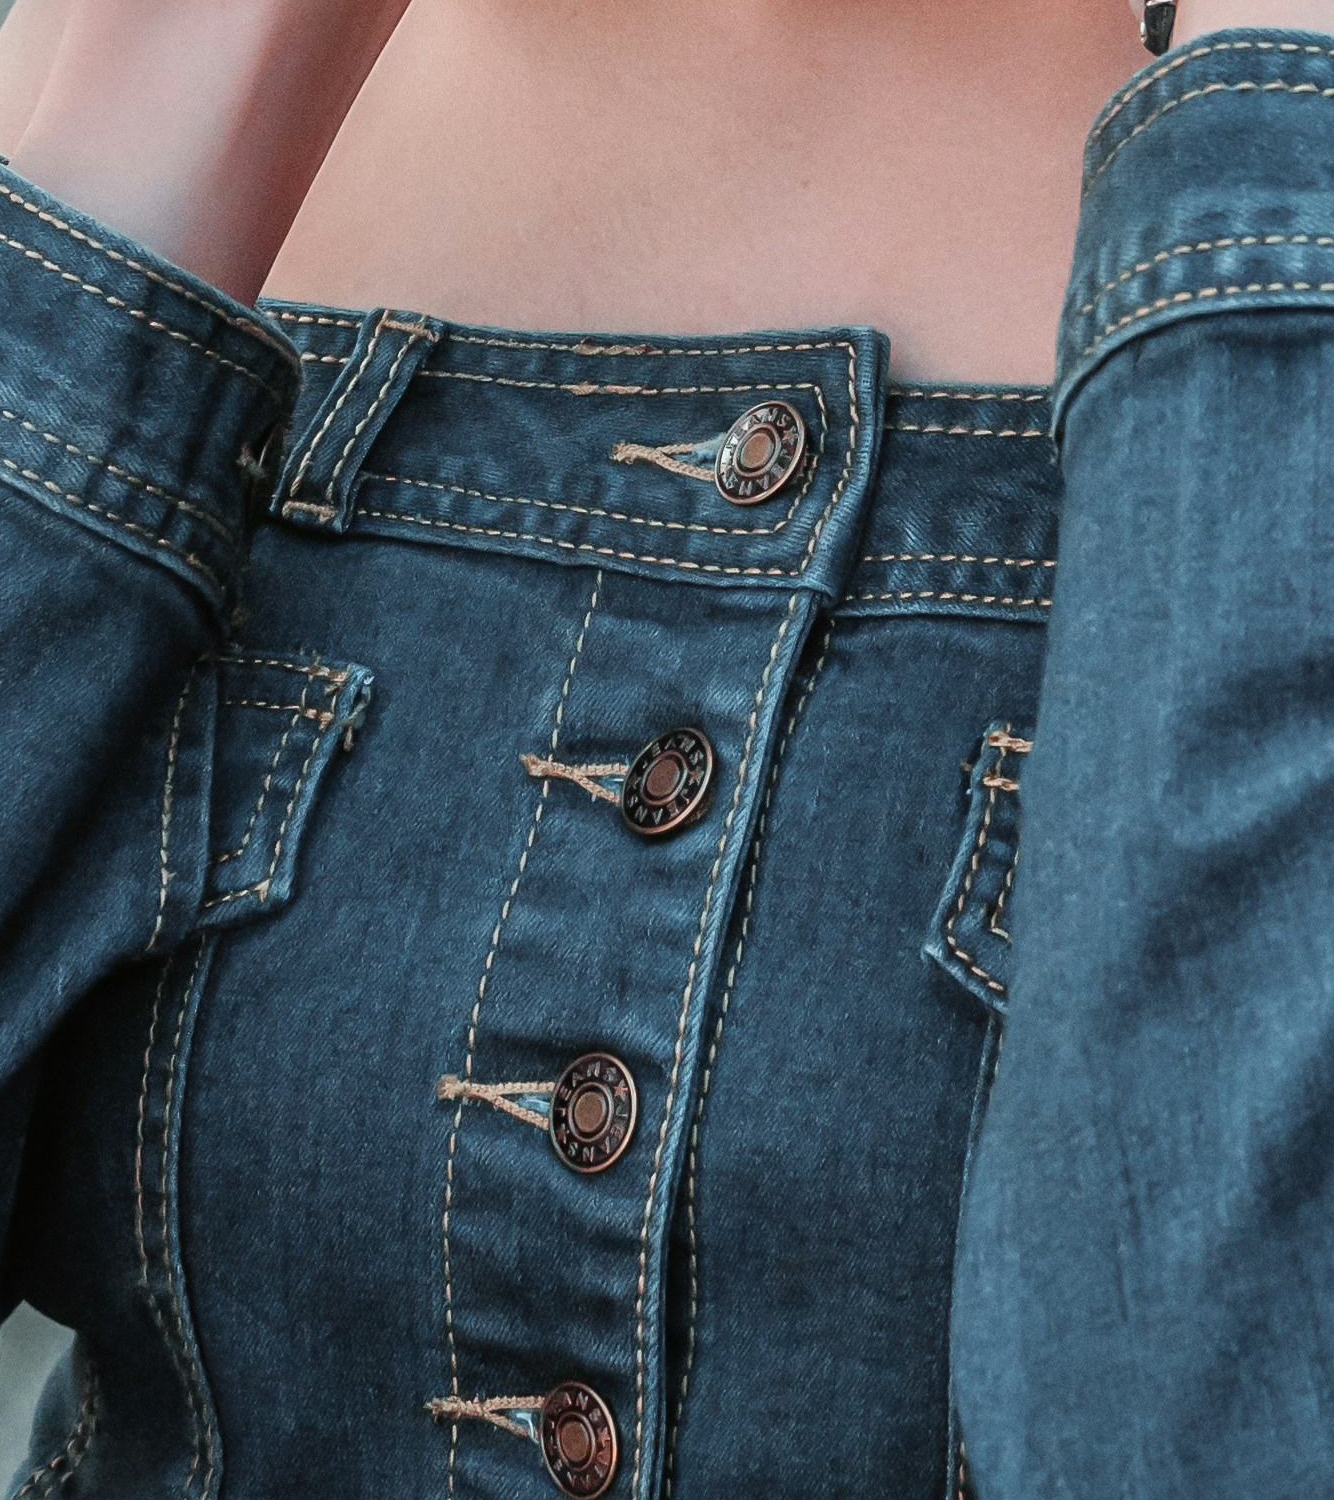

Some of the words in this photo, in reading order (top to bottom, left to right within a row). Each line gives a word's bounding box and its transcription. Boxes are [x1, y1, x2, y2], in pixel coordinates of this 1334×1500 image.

[627, 788, 690, 825] JEANS
[554, 1061, 617, 1117] JEANS
[568, 1106, 628, 1163] JEANS
